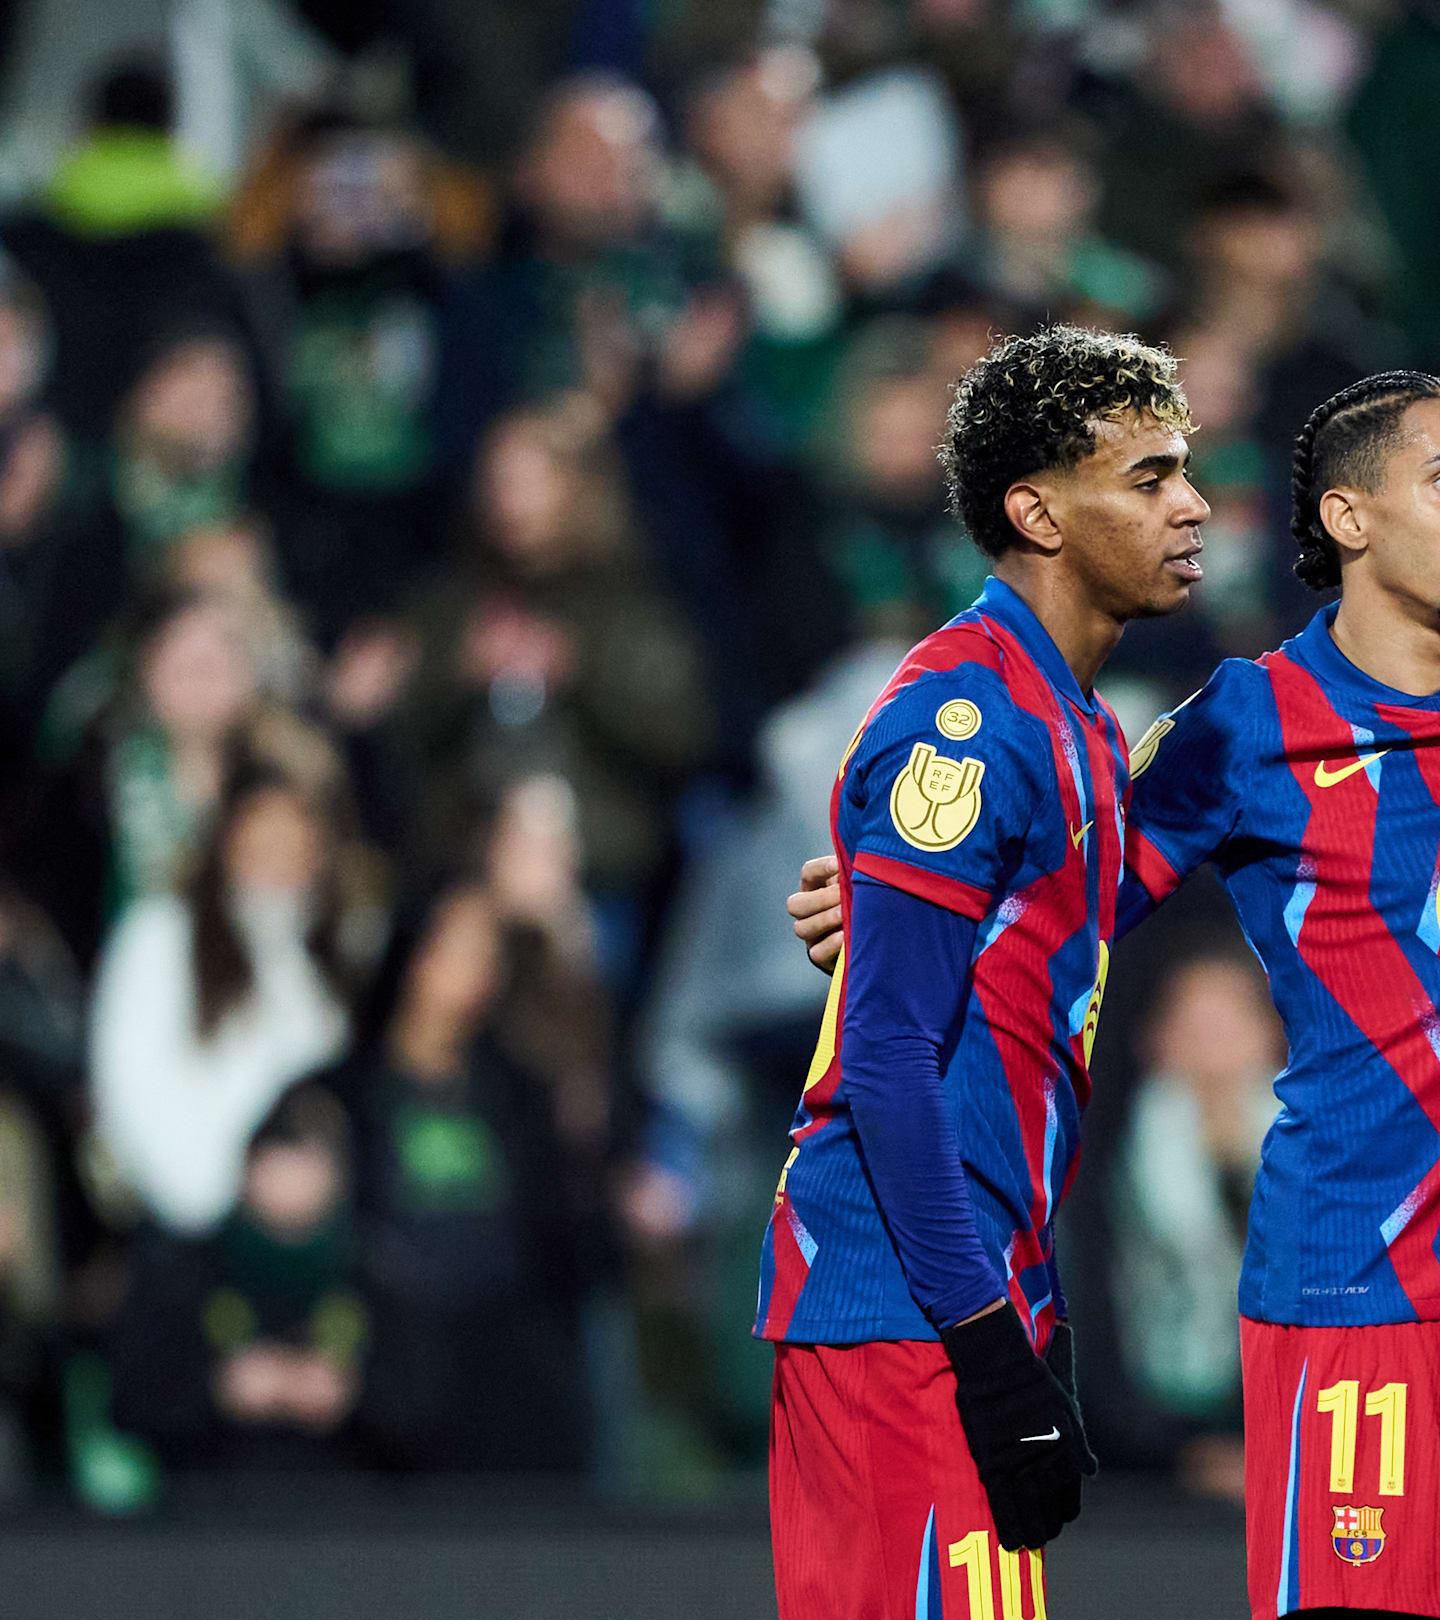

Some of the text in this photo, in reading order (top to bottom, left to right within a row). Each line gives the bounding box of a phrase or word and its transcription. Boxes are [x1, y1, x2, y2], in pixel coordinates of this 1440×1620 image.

[947, 712, 970, 726] 32
[1316, 1379, 1408, 1497] 11
[948, 1530, 1047, 1620] 10
